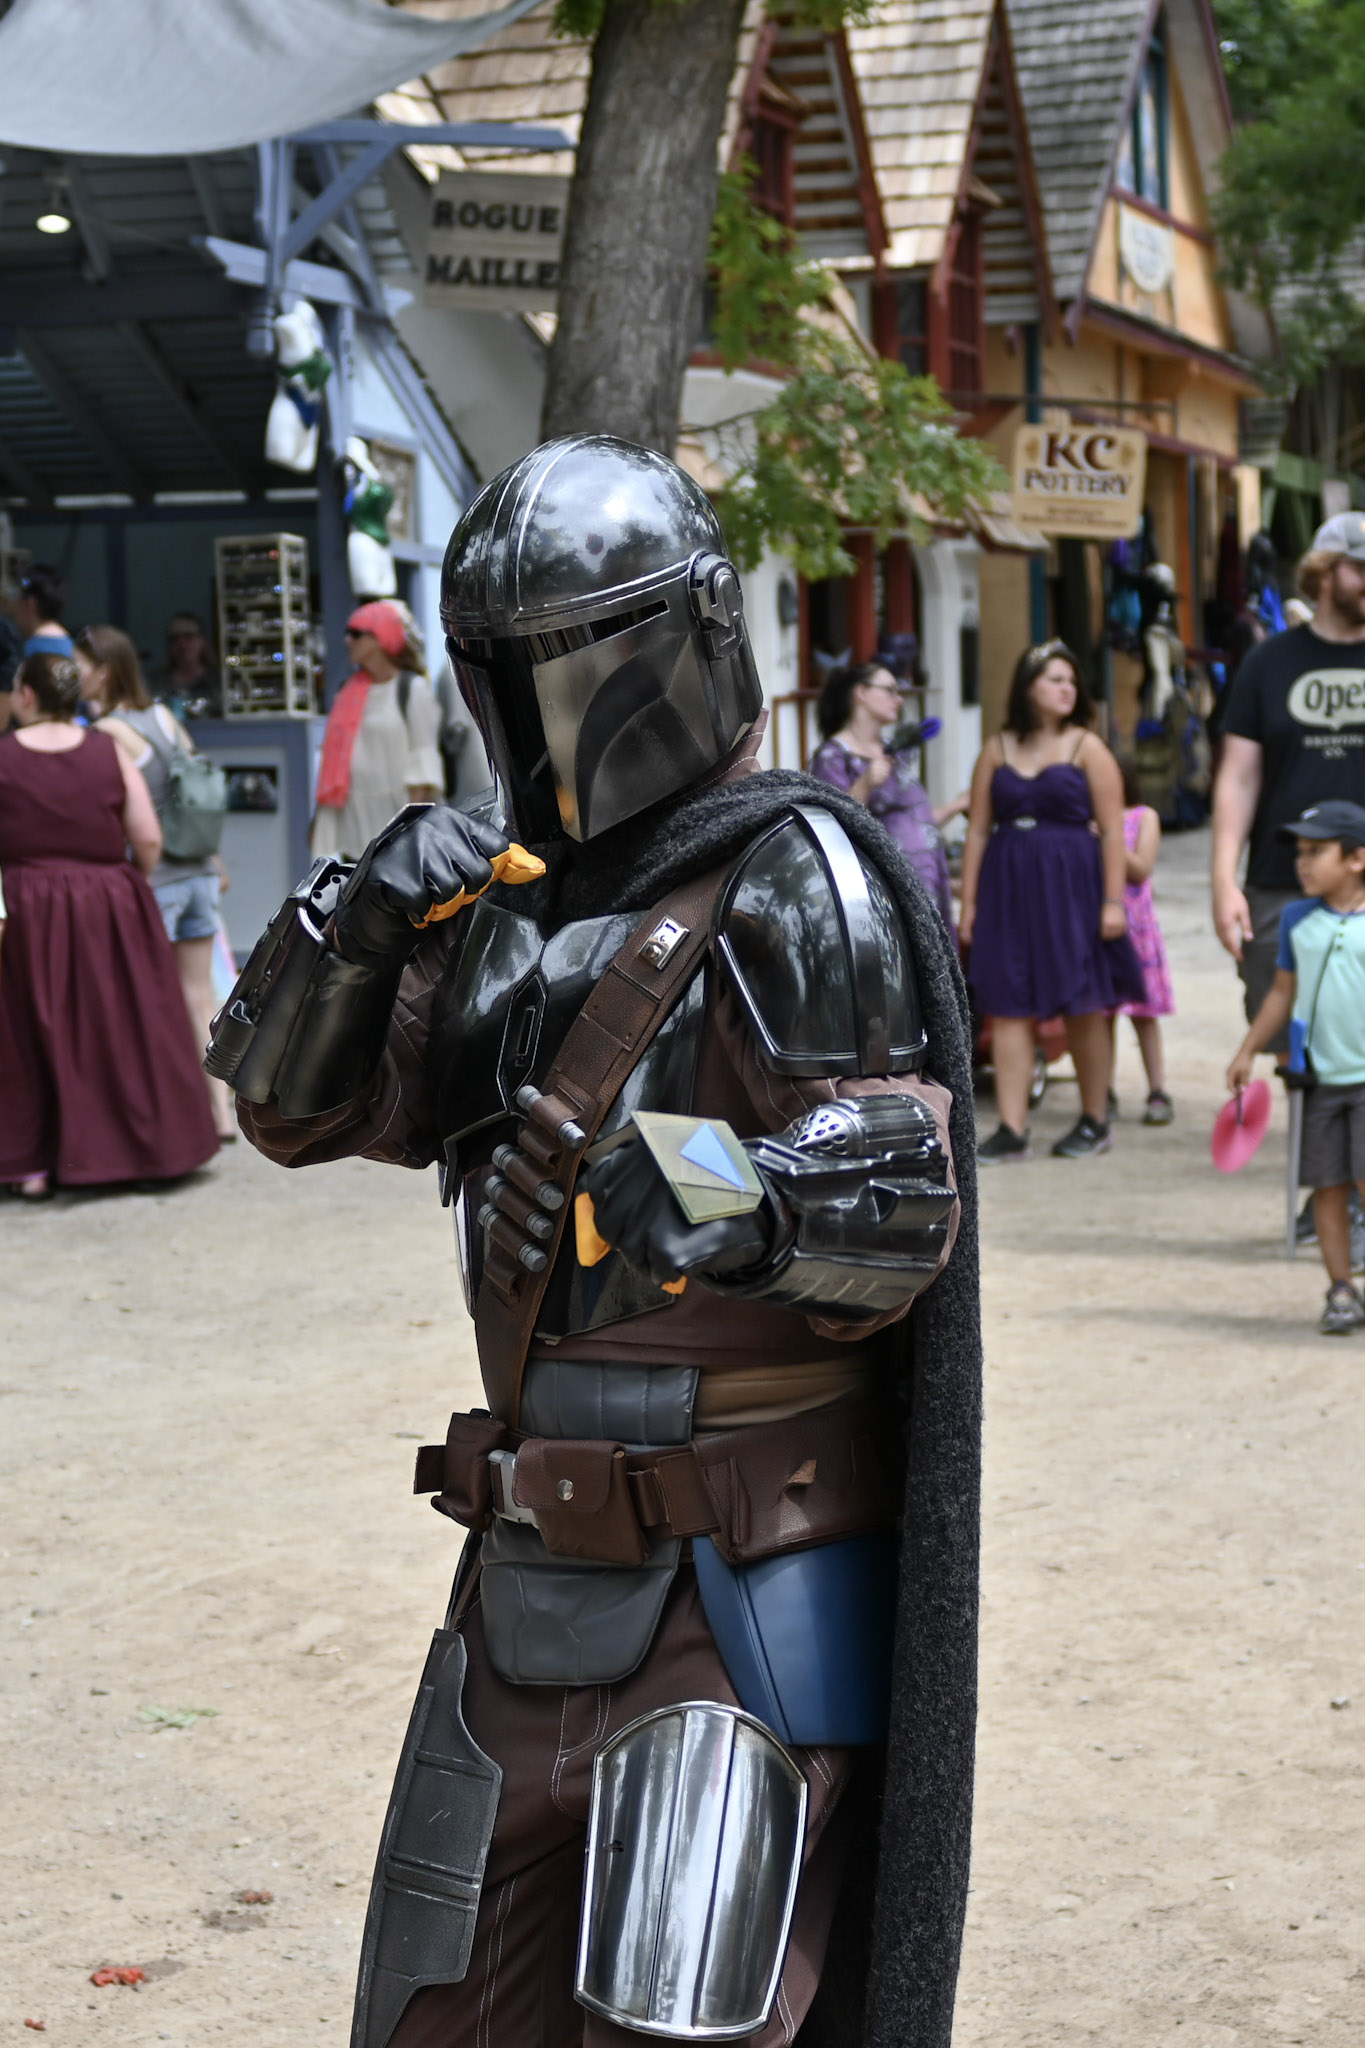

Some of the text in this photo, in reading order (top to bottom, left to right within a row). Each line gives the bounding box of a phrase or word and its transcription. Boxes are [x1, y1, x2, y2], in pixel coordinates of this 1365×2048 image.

[434, 200, 559, 232] ROGUE
[427, 255, 559, 288] MAILLE
[1046, 432, 1117, 471] KC
[1024, 469, 1131, 495] POTTERY
